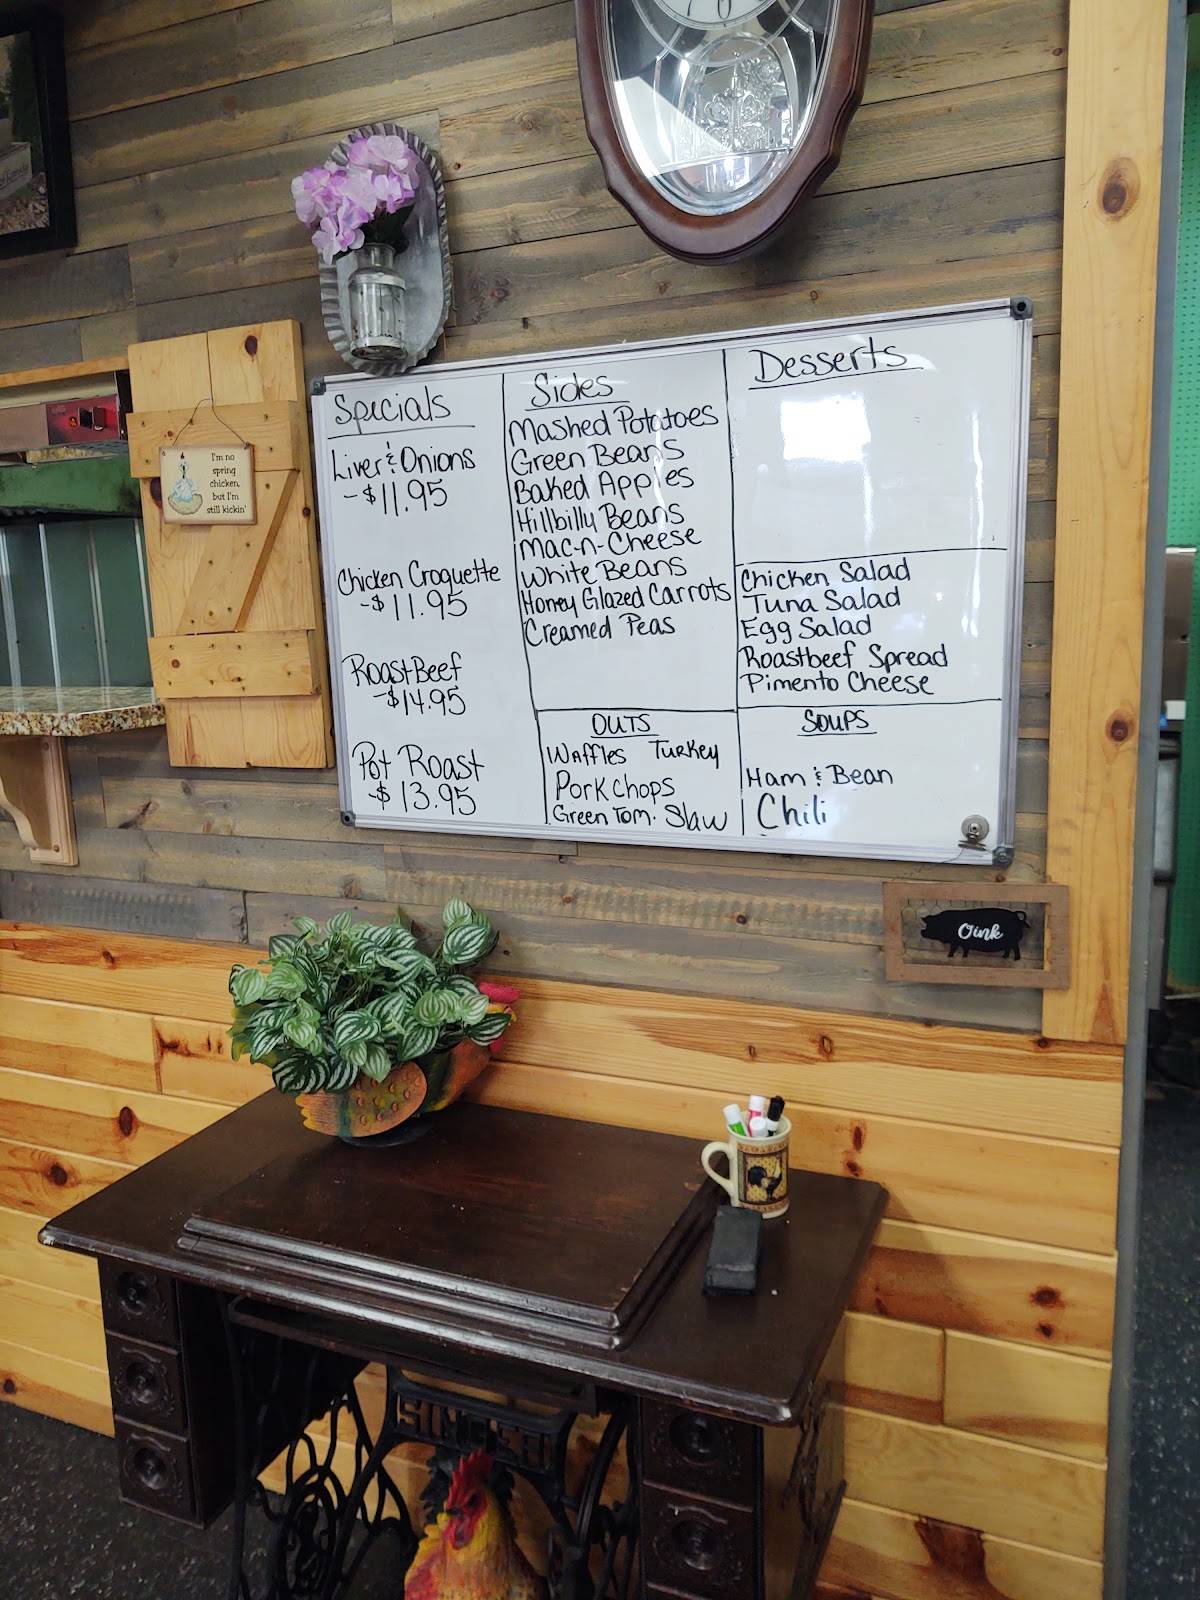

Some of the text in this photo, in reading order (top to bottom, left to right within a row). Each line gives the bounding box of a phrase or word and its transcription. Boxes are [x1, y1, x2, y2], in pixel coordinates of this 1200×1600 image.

[749, 337, 907, 383] Desserts
[531, 372, 614, 407] Sides
[335, 385, 451, 435] Specials
[509, 405, 719, 447] Mashed Potatoes
[211, 452, 235, 462] I'm no
[212, 466, 237, 477] spring
[332, 449, 382, 482] Liver
[400, 446, 476, 474] Onions
[511, 439, 685, 476] Green Beans
[212, 492, 239, 501] but I'm
[514, 467, 695, 505] Baked Apples
[206, 504, 247, 514] still kickin'
[517, 503, 685, 534] Hillbilly Beans
[338, 558, 502, 595] Chicken Croquette
[521, 557, 687, 589] White Beans
[741, 557, 911, 592] Chicken Salad
[521, 577, 732, 618] Honey Glazed Carrots
[743, 586, 901, 614] Tuna Salad
[524, 613, 676, 647] Creamed Peas
[741, 614, 872, 644] Egg Salad
[868, 643, 948, 673] Spread
[739, 671, 934, 694] Pimento Cheese
[592, 713, 651, 735] OUTS
[352, 741, 485, 781] Pot Roast
[746, 767, 806, 788] Ham
[826, 764, 893, 785] Bean
[553, 804, 608, 825] Green
[664, 802, 728, 831] Slaw
[757, 792, 827, 830] Chili
[957, 922, 1004, 942] Oink
